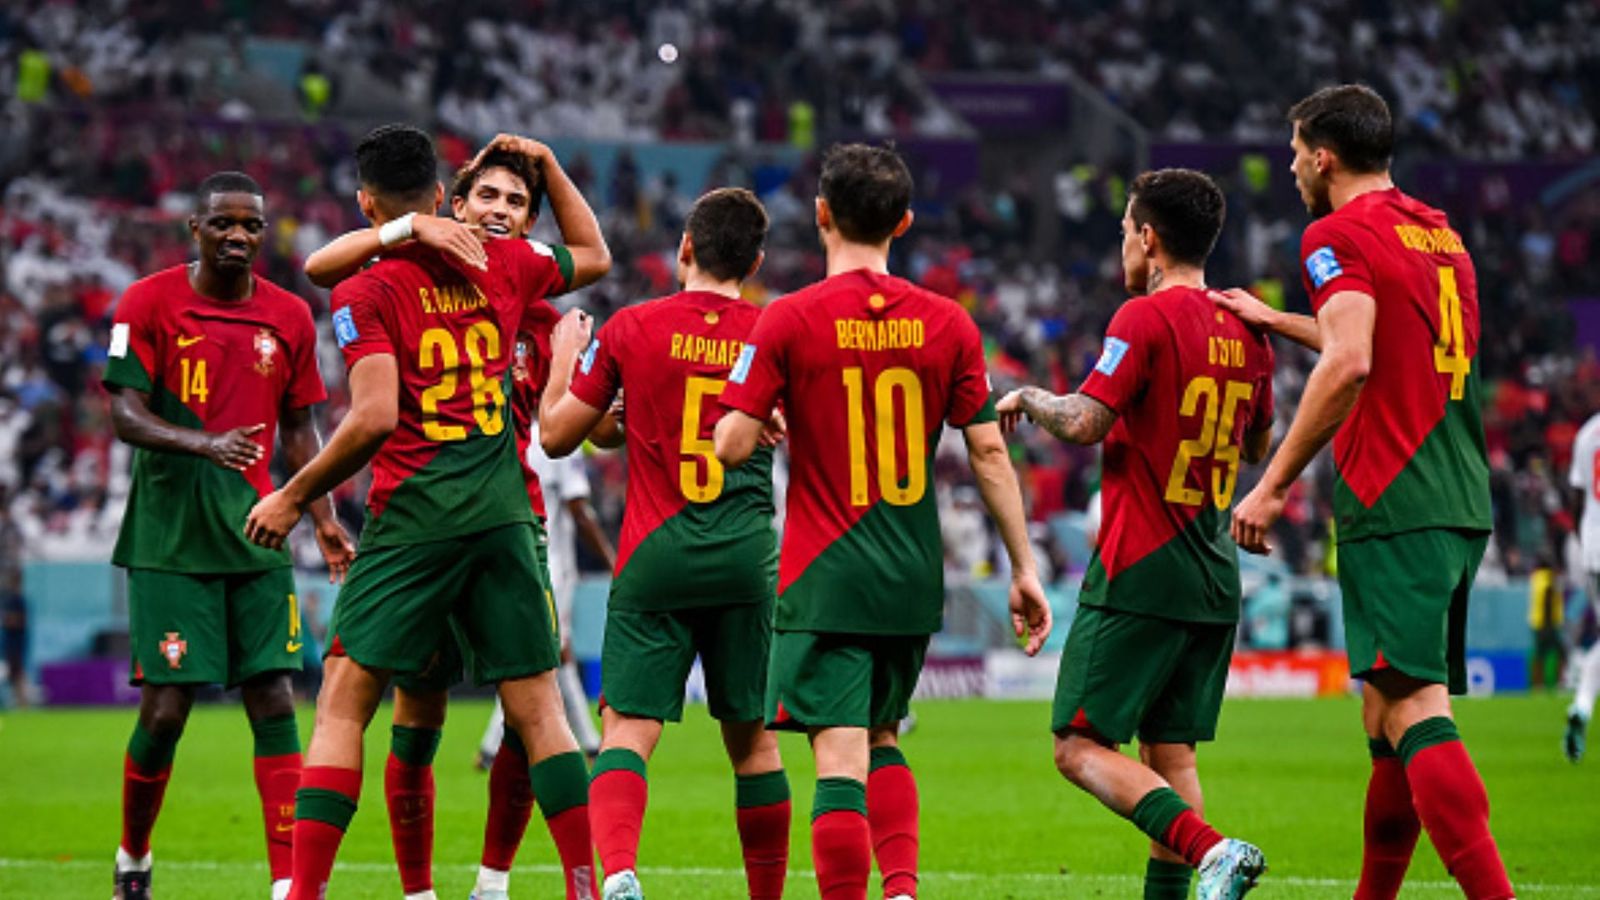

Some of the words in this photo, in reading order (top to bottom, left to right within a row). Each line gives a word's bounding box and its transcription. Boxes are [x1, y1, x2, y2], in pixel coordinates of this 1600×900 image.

[181, 358, 209, 403] 14
[419, 320, 505, 441] 26
[835, 319, 925, 351] BERNARDO
[1434, 266, 1470, 400] 4
[679, 376, 727, 503] 5
[842, 367, 927, 506] 10
[1165, 376, 1253, 511] 25
